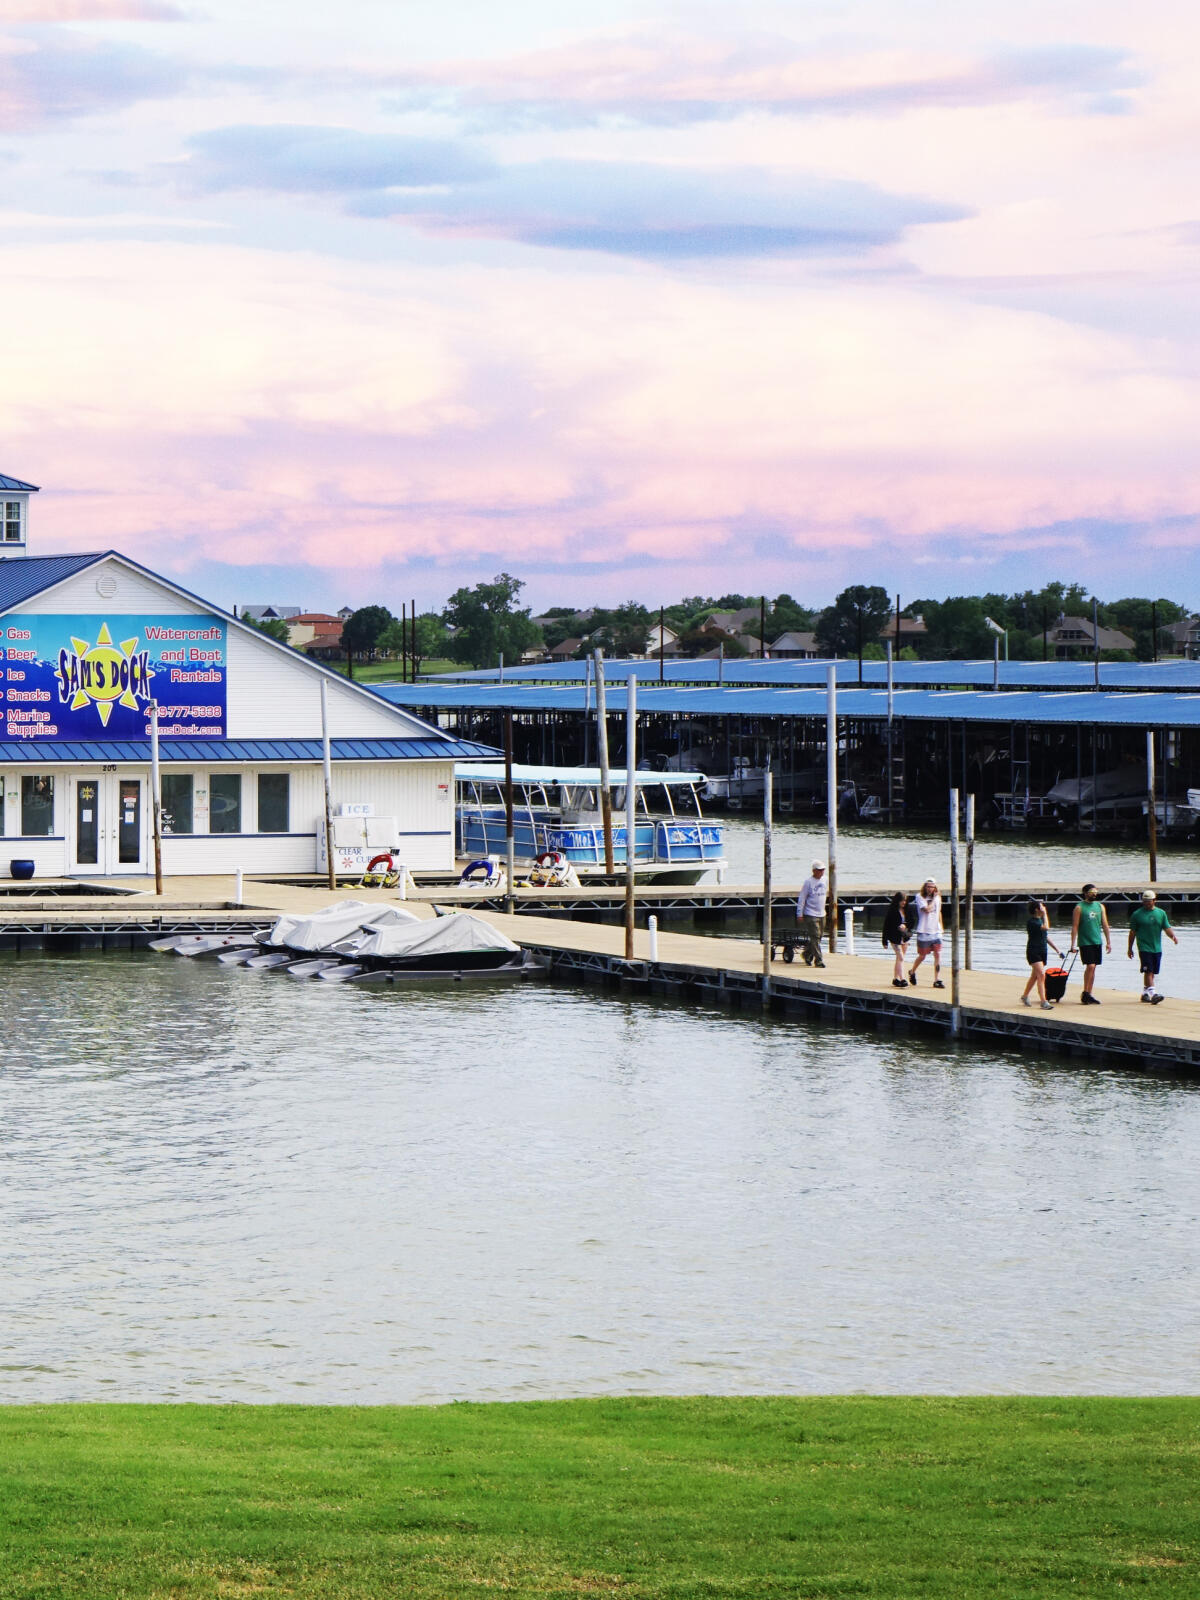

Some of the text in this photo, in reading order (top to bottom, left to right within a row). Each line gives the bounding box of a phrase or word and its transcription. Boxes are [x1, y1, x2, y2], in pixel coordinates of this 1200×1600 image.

[7, 628, 30, 640] Gas
[145, 627, 221, 640] Watercraft
[7, 649, 36, 660] Beer
[161, 649, 221, 661] and Boat
[7, 669, 25, 681] Ice
[58, 648, 151, 703] SAM'S DOCK
[171, 669, 222, 682] Rentals
[7, 689, 51, 701] Snacks
[7, 710, 50, 721] Marine
[144, 706, 222, 718] 49-777-5338
[7, 723, 58, 737] Supplies
[145, 724, 222, 735] SmsDock.com
[348, 805, 369, 814] ICE
[339, 848, 361, 856] CLEAR
